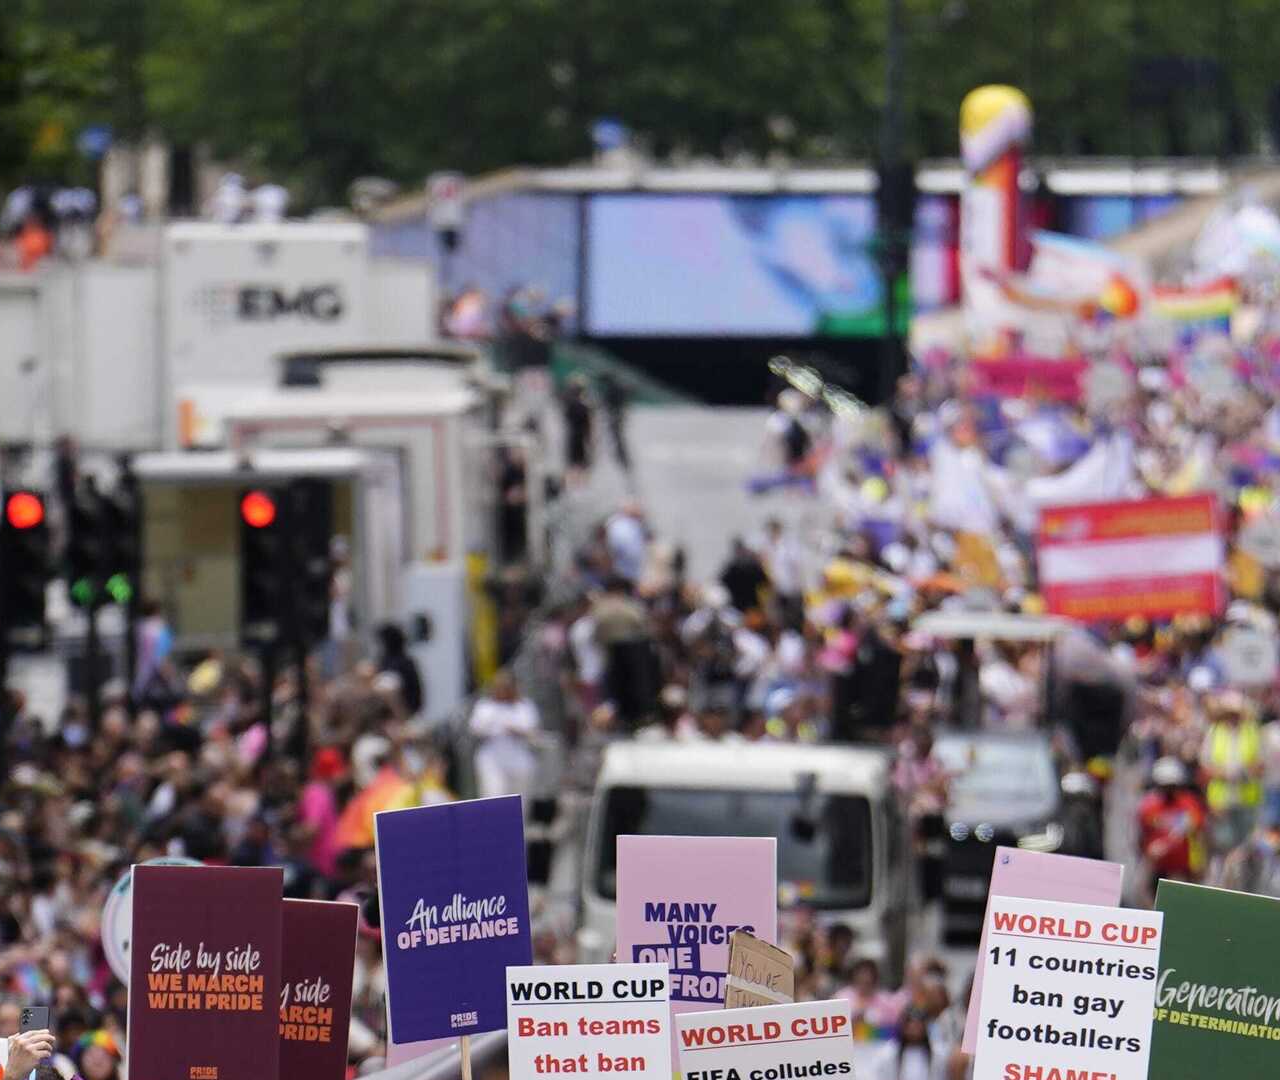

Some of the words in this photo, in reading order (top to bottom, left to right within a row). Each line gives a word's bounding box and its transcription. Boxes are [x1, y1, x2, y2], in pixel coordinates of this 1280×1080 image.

[239, 287, 344, 323] EMG
[405, 898, 438, 935] An
[441, 893, 507, 924] alliance
[645, 902, 717, 922] MANY
[397, 932, 421, 950] OF
[425, 917, 519, 946] DEFIANCE
[994, 911, 1092, 939] WORLD
[1101, 923, 1158, 945] CUP
[150, 942, 192, 972] Side
[196, 942, 221, 977] by
[224, 943, 261, 973] side
[638, 948, 692, 969] ONE
[990, 947, 1017, 967] 11
[1028, 954, 1156, 981] countries
[148, 973, 183, 992] WE
[187, 973, 264, 993] MARCH
[294, 975, 331, 1006] side
[511, 981, 603, 1001] WORLD
[613, 979, 665, 999] CUP
[672, 974, 725, 1000] FRO
[148, 993, 201, 1010] WITH
[205, 993, 263, 1010] PRIDE
[279, 1006, 333, 1026] ARCH
[1012, 984, 1063, 1008] ban
[1073, 994, 1124, 1019] gay
[518, 1017, 568, 1037] Ban
[578, 1016, 661, 1036] teams
[681, 1021, 781, 1047] WORLD
[791, 1015, 848, 1039] CUP
[987, 1018, 1141, 1053] footballers
[534, 1054, 588, 1073] that
[598, 1053, 646, 1072] ban
